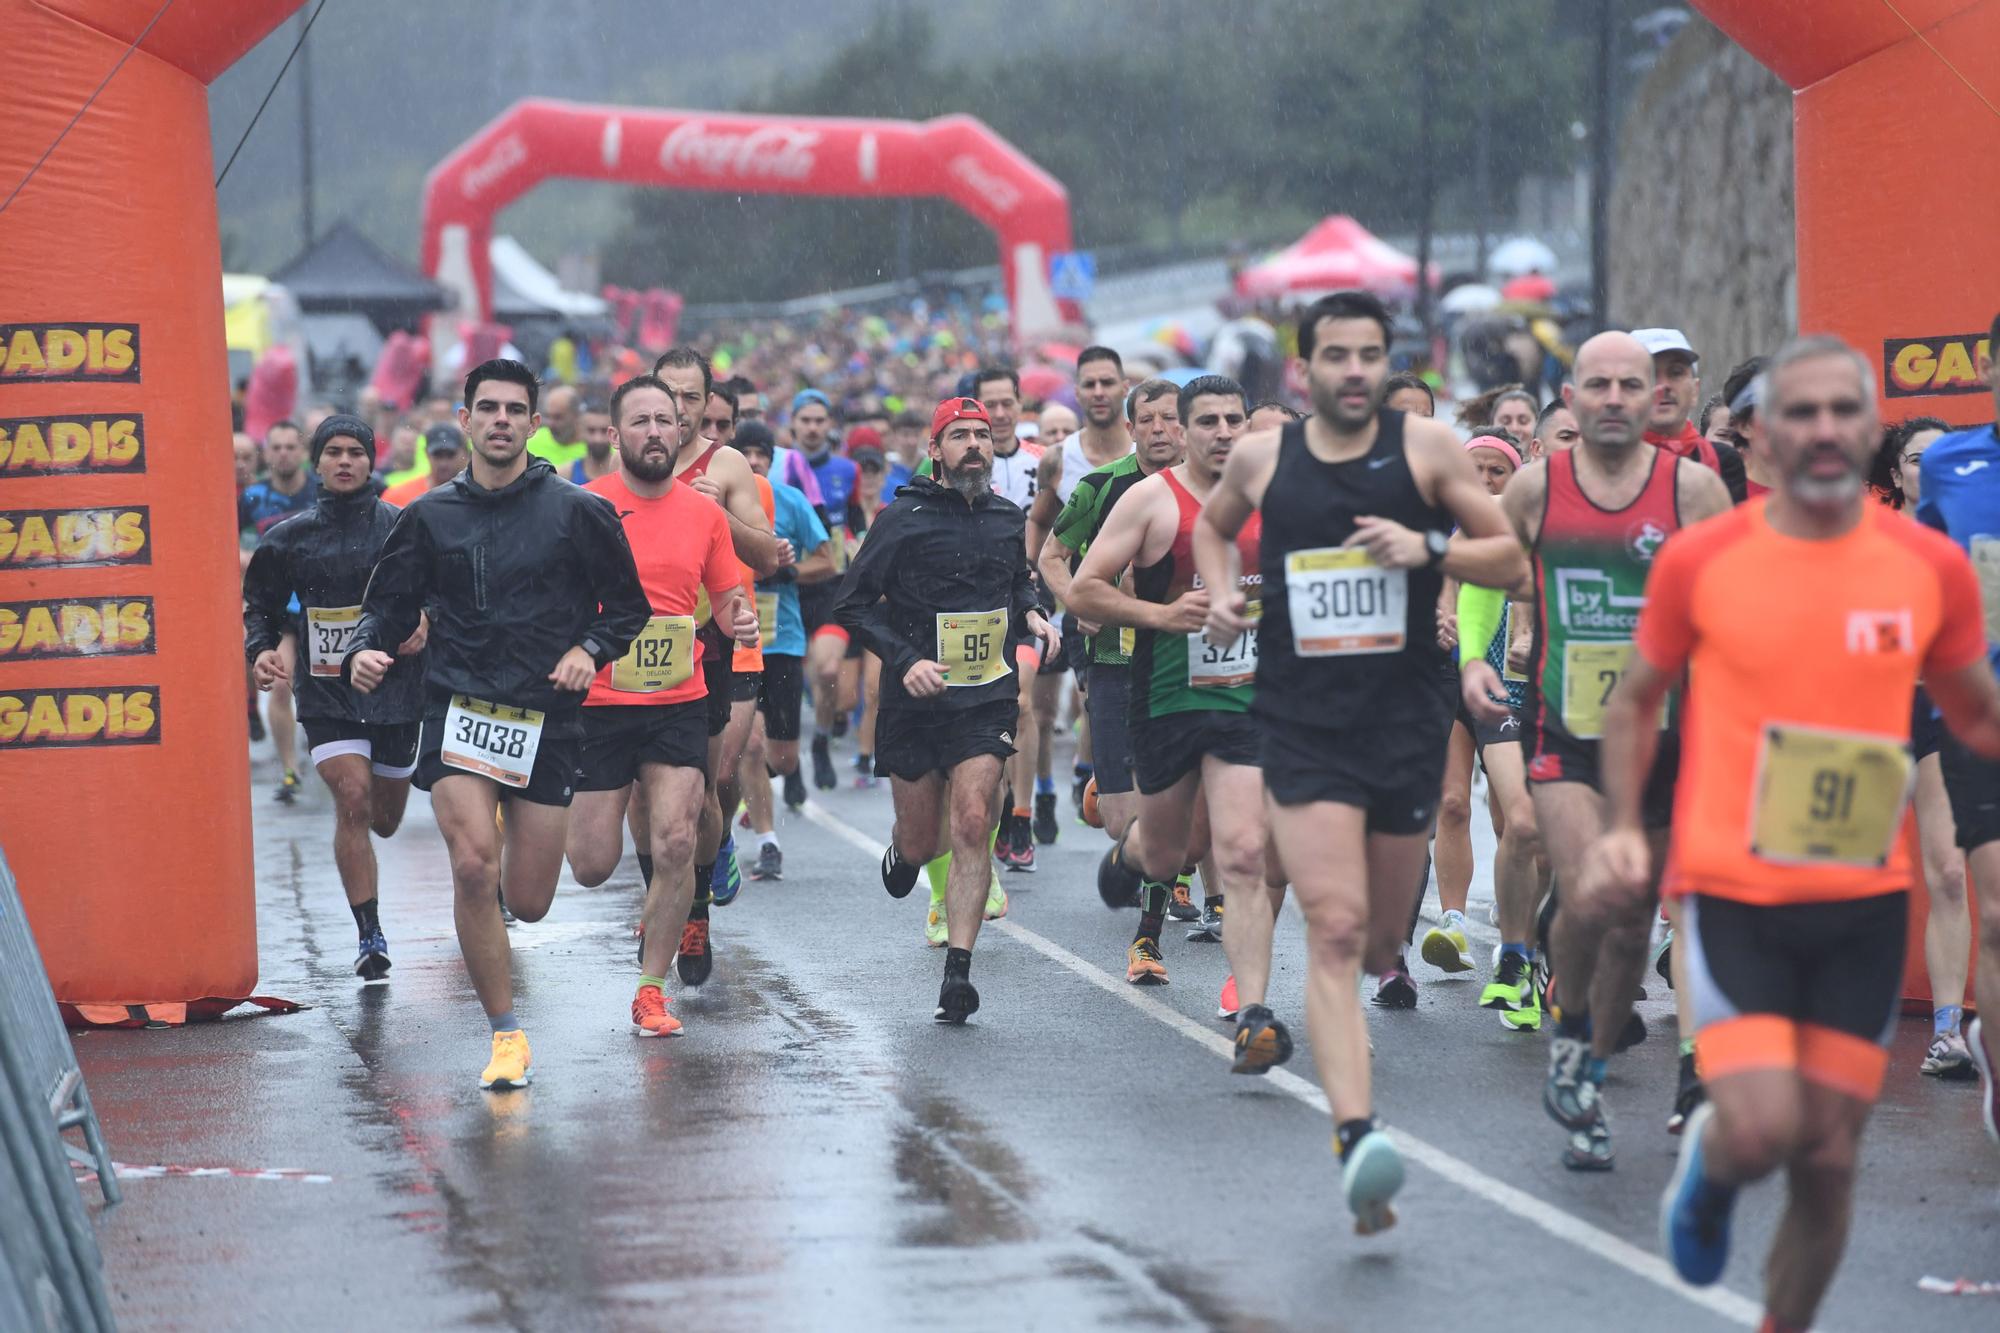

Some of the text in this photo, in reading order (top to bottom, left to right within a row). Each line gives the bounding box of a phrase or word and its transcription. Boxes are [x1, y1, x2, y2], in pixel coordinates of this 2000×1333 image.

[0, 329, 135, 375] ADIS
[0, 419, 140, 469] ADIS
[1308, 578, 1387, 619] 3001
[1570, 585, 1602, 609] by
[636, 639, 672, 667] 132
[964, 633, 990, 662] 95
[456, 715, 528, 759] 3038
[1808, 769, 1857, 821] 91
